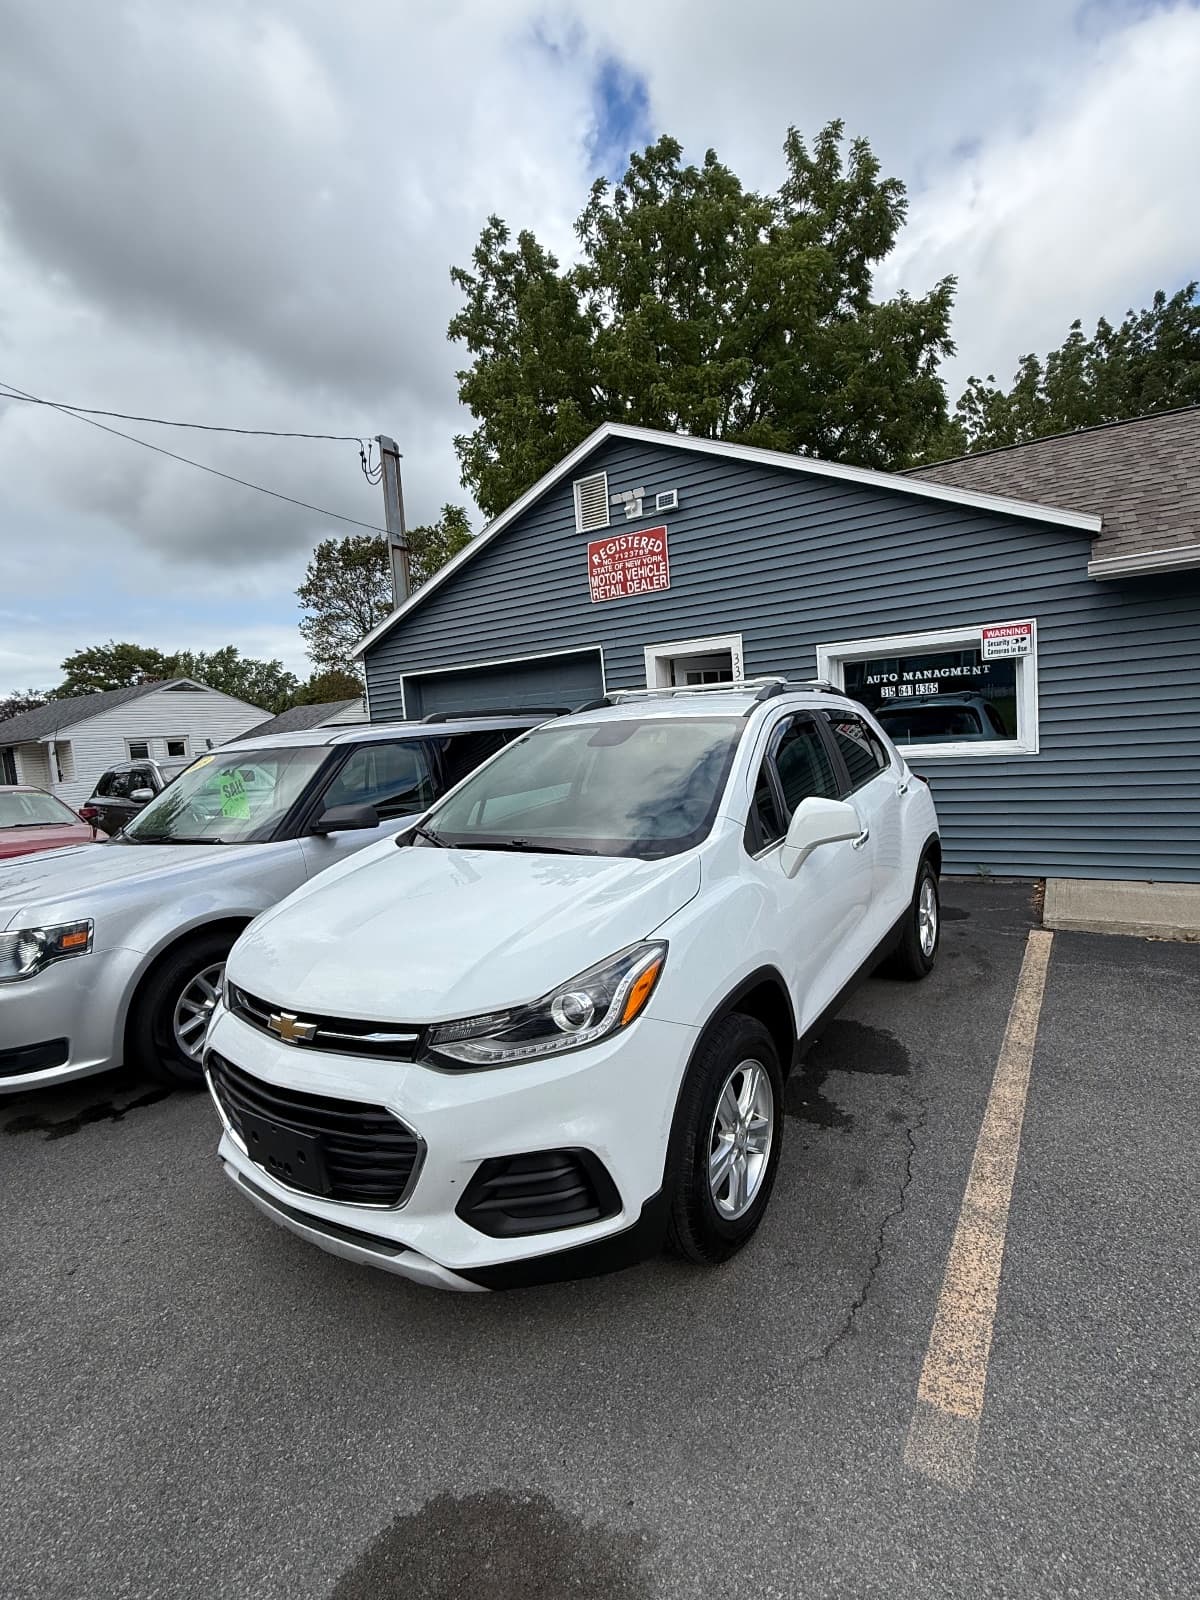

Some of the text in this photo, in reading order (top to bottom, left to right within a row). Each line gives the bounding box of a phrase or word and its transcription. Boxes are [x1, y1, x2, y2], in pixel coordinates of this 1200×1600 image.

[592, 537, 662, 565] REGISTERED
[592, 562, 666, 588] MOTOR VEHICLE
[593, 555, 663, 576] STATE OF NEW YORK
[593, 575, 667, 600] RETAIL DEALER
[987, 627, 1028, 638] WARNING
[987, 639, 1010, 647] Security
[866, 665, 991, 684] AUTO MANAGMENT
[881, 686, 896, 697] 315
[915, 682, 939, 695] 4365
